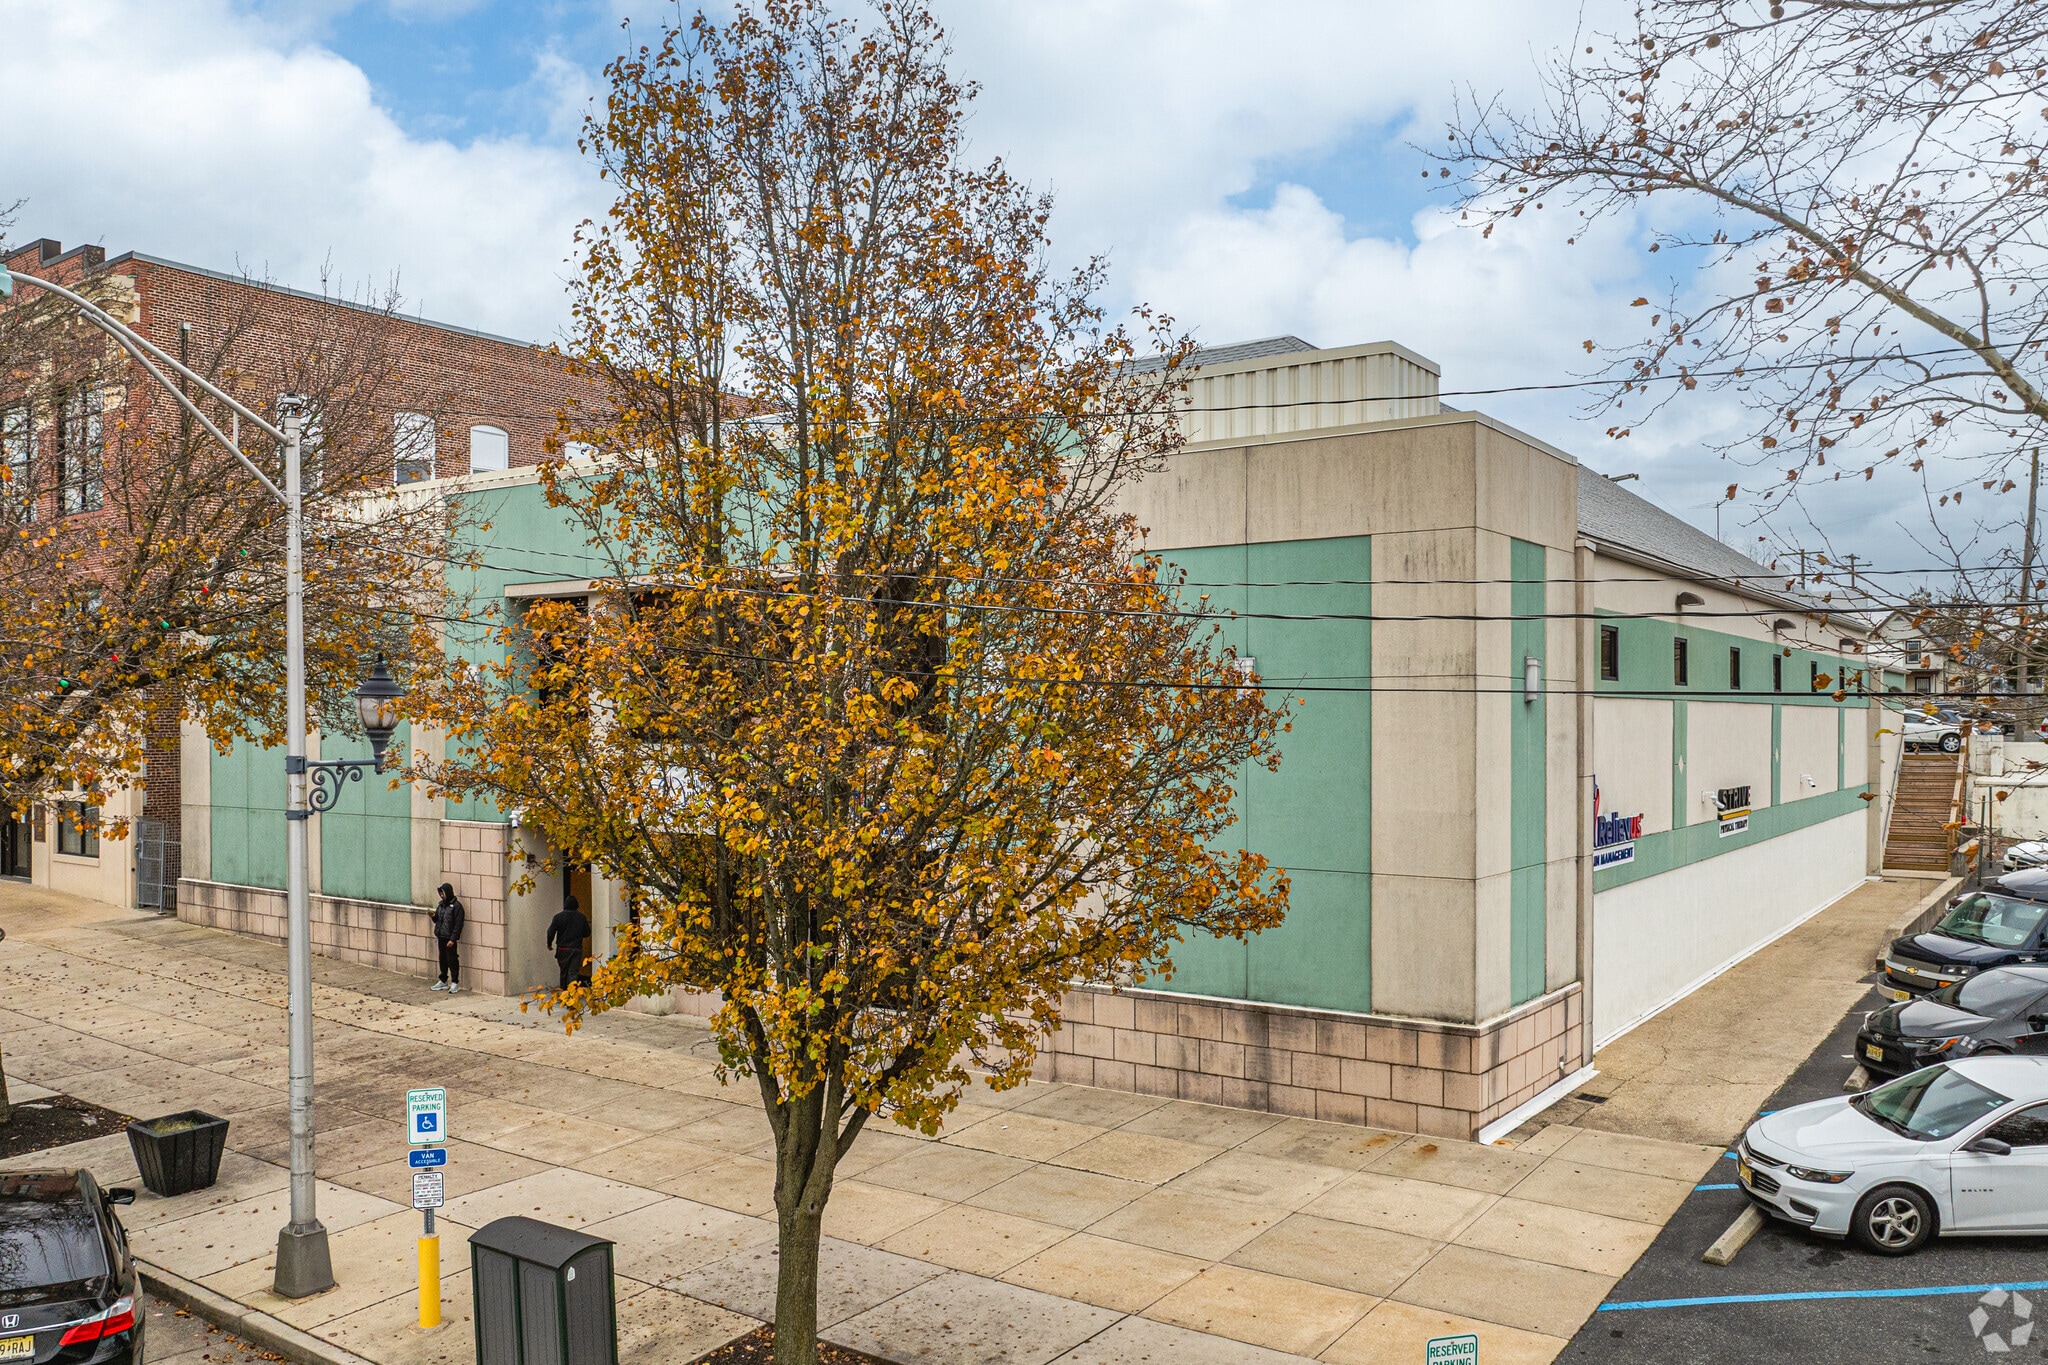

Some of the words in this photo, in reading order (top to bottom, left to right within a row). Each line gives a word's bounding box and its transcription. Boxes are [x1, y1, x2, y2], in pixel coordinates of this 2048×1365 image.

[1718, 785, 1751, 811] STRIVE
[1600, 846, 1634, 865] MANAGEMENT
[410, 1093, 443, 1102] RESERVED
[412, 1103, 441, 1111] PARKING
[1430, 1343, 1474, 1358] RESERVED
